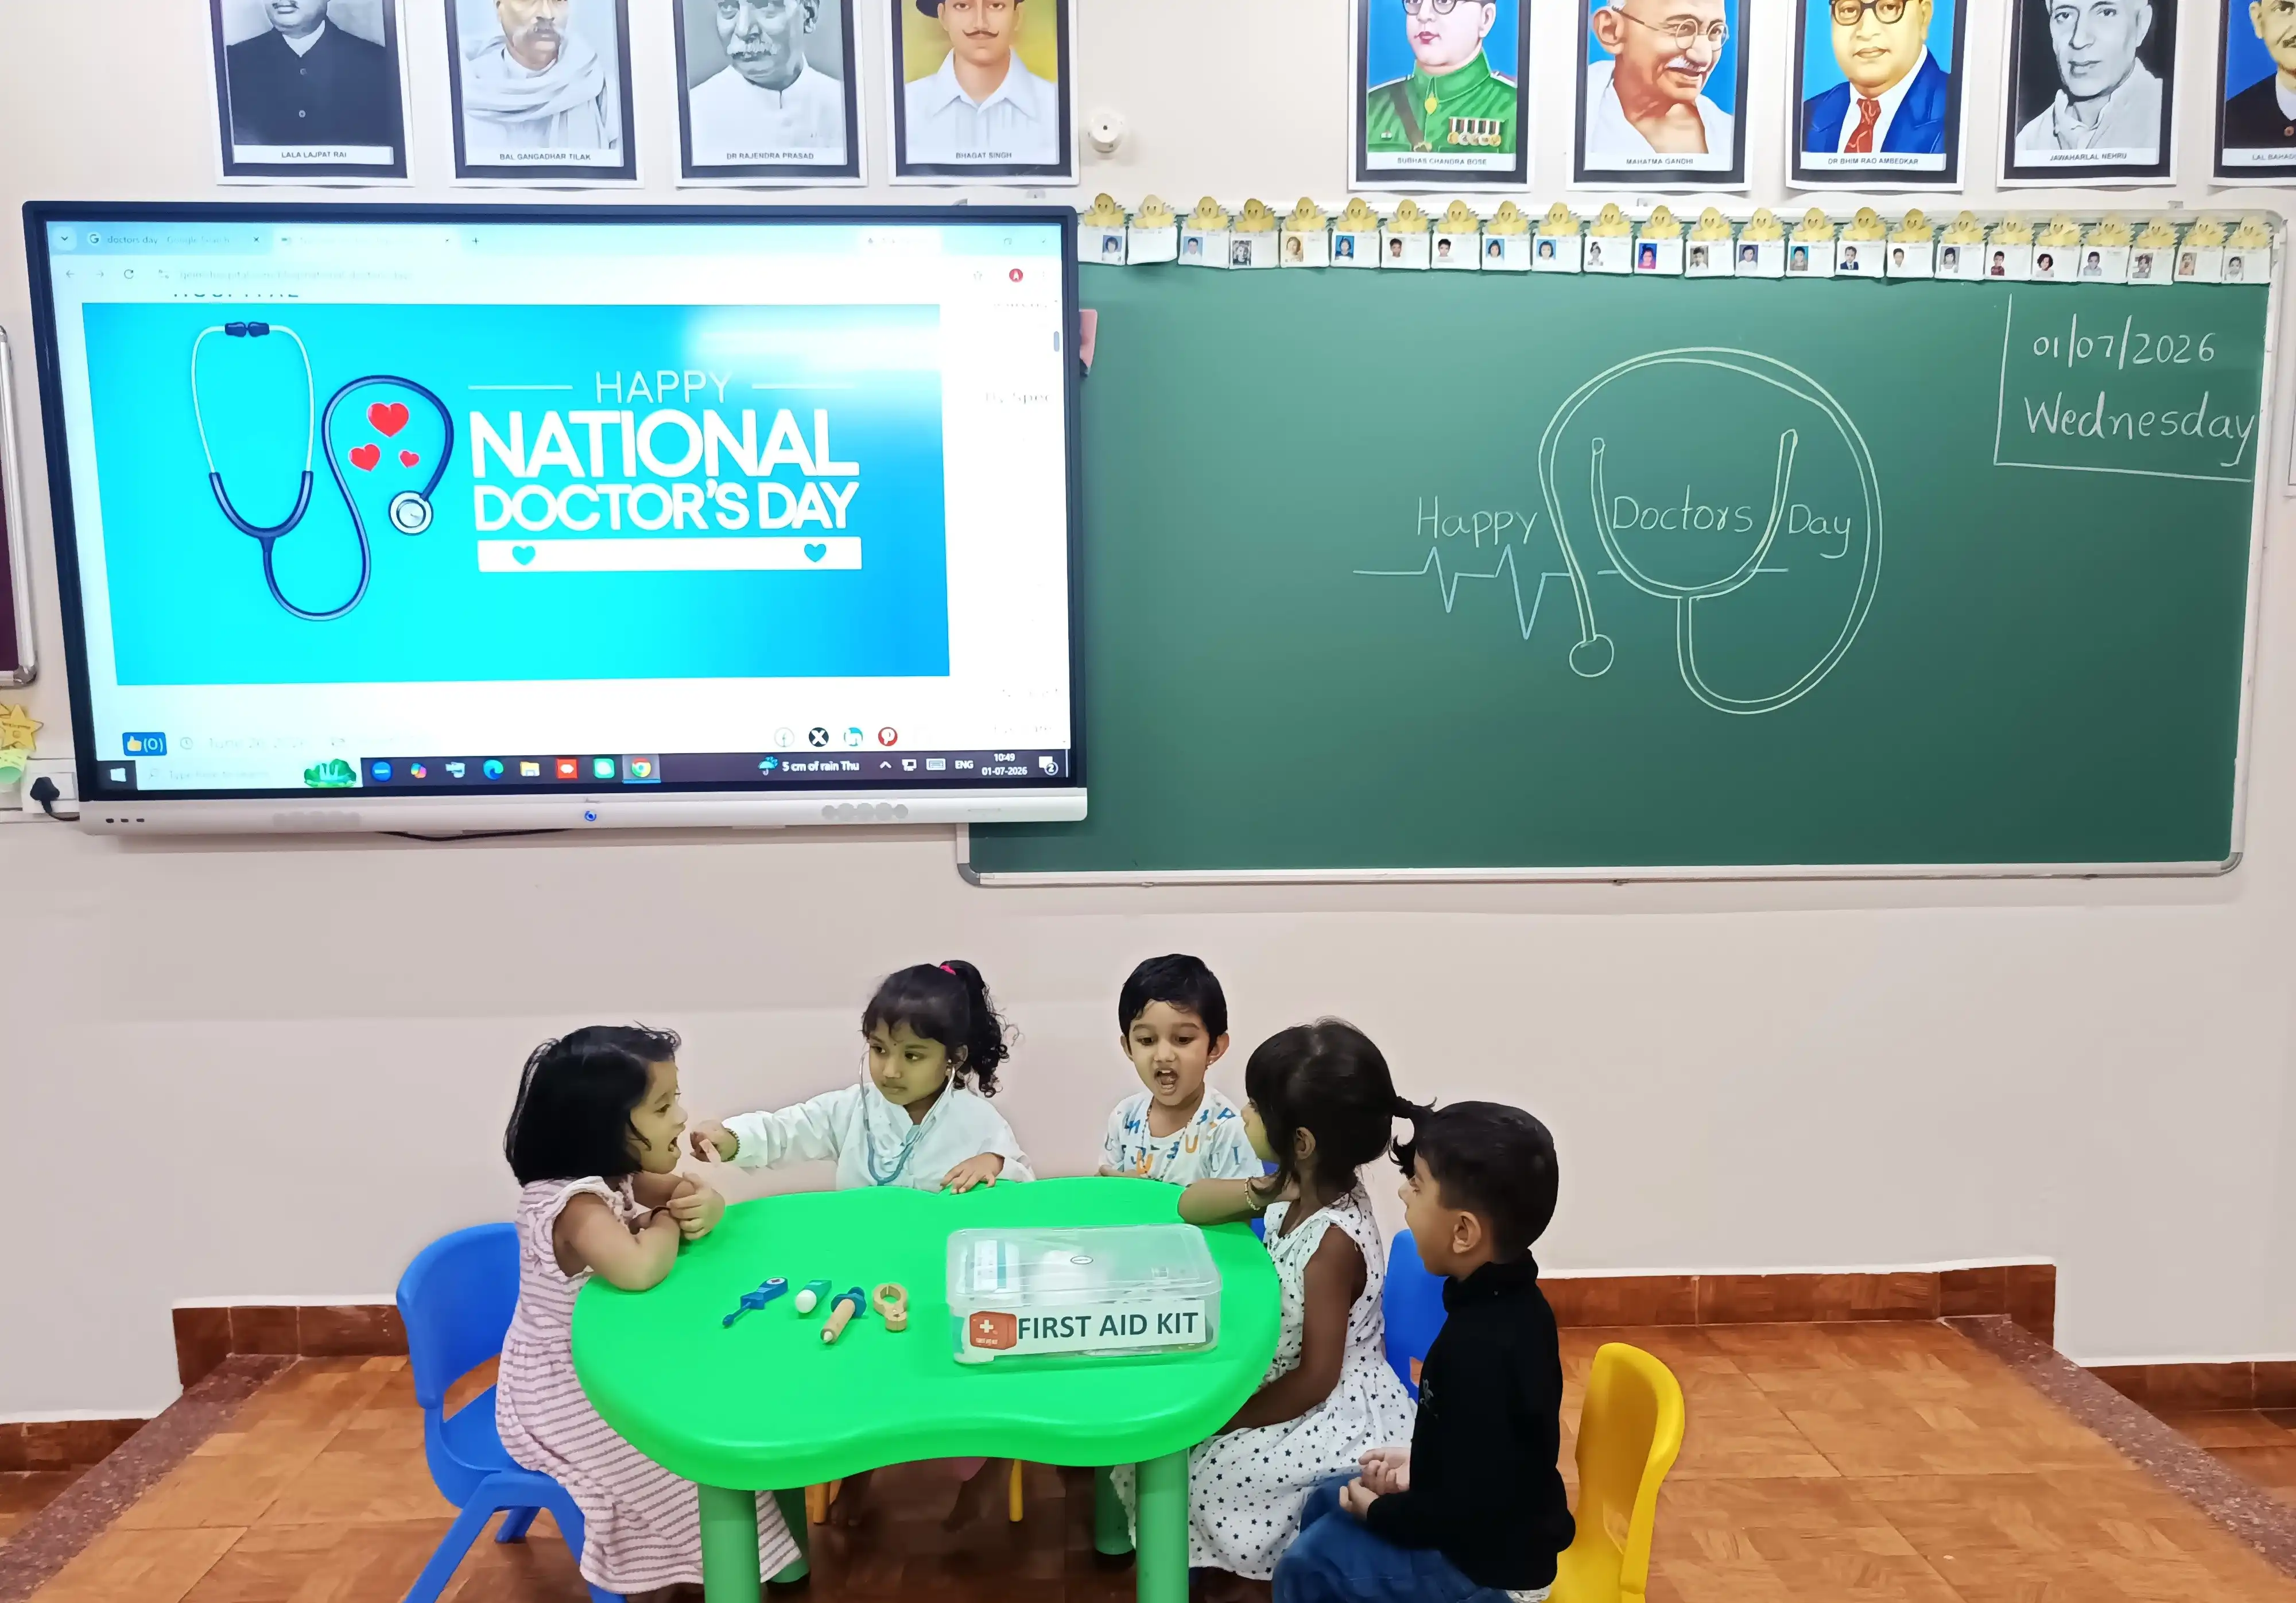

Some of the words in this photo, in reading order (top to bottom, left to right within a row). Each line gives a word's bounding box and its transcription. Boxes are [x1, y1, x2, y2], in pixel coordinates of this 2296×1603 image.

[142, 236, 158, 246] day
[2033, 313, 2216, 370] 01/07/2026
[595, 370, 733, 403] HAPPY
[469, 408, 860, 478] NATIONAL
[2024, 390, 2255, 467] Wednesday
[474, 478, 750, 531] DOCTOR'S
[757, 482, 860, 530] DAY
[1417, 495, 1538, 548] Happy
[1612, 484, 1753, 532] Doctors
[1789, 503, 1851, 559] Day
[782, 762, 789, 771] 5
[791, 763, 806, 771] cm
[808, 761, 819, 771] of
[820, 761, 839, 771] rain
[840, 760, 860, 771] Thu
[955, 760, 974, 769] ENG
[982, 766, 1027, 775] 01-07-2026
[994, 753, 1015, 762] 10:49
[1018, 1316, 1091, 1340] FIRST
[1099, 1314, 1147, 1336] AID
[1157, 1312, 1199, 1334] KIT
